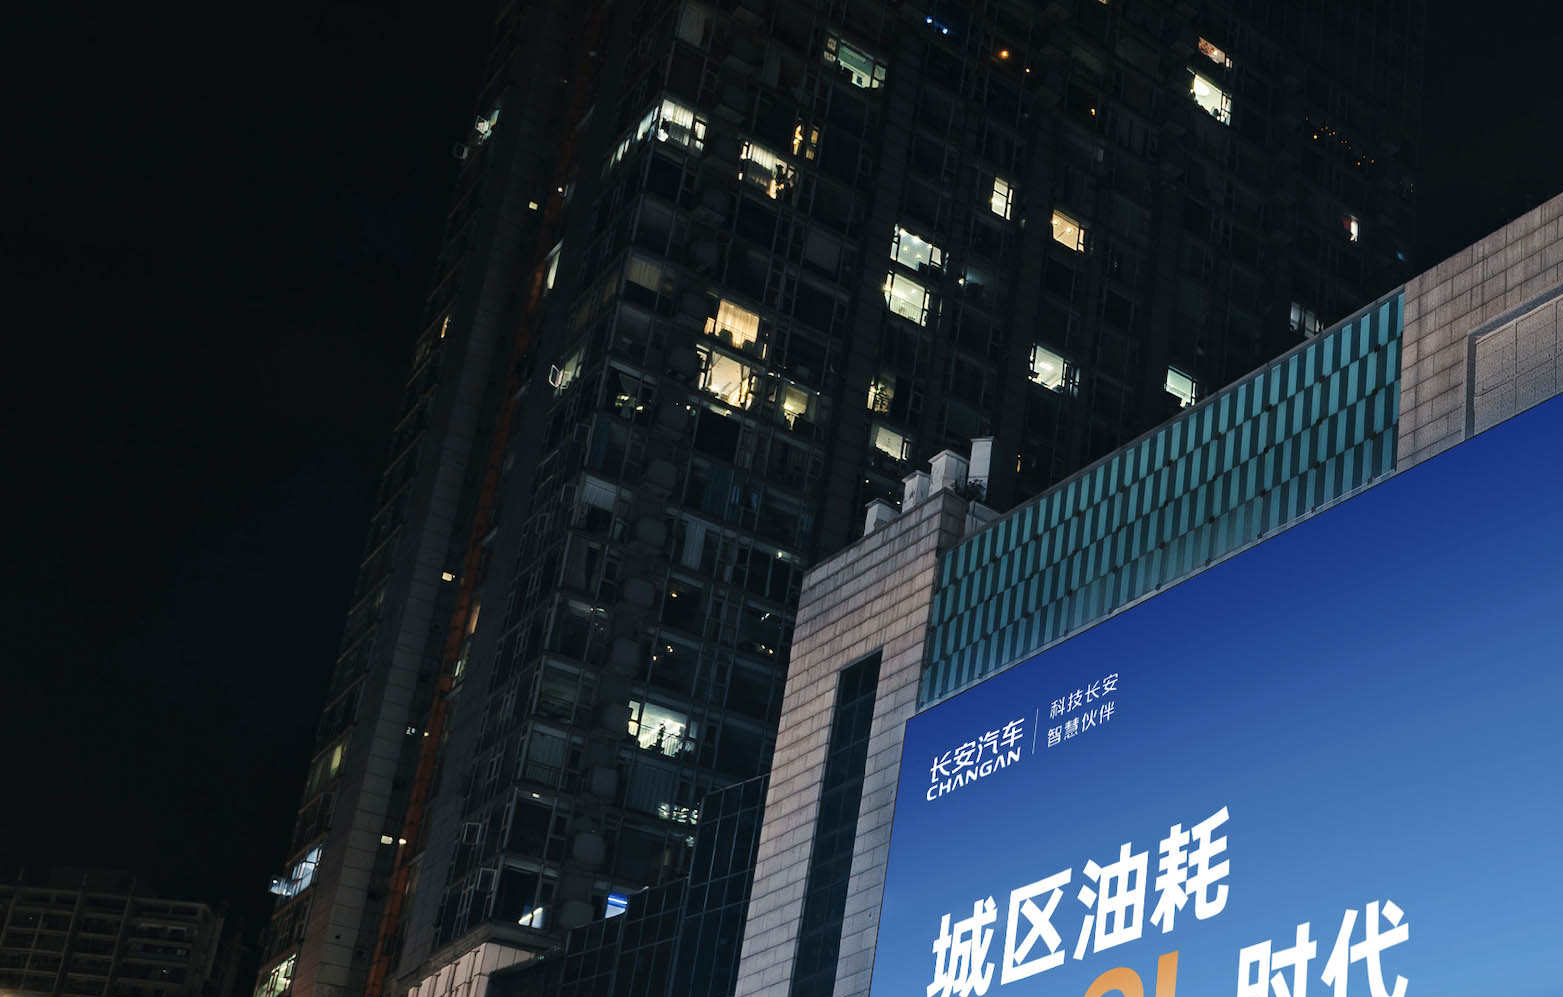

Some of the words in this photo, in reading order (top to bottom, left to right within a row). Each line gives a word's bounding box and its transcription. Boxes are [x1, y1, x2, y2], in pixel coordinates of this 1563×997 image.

[1049, 672, 1119, 718] 科技长安
[1047, 701, 1115, 748] 智慧伙伴
[926, 747, 1021, 801] CHANGAN
[930, 718, 1025, 784] 长安汽车
